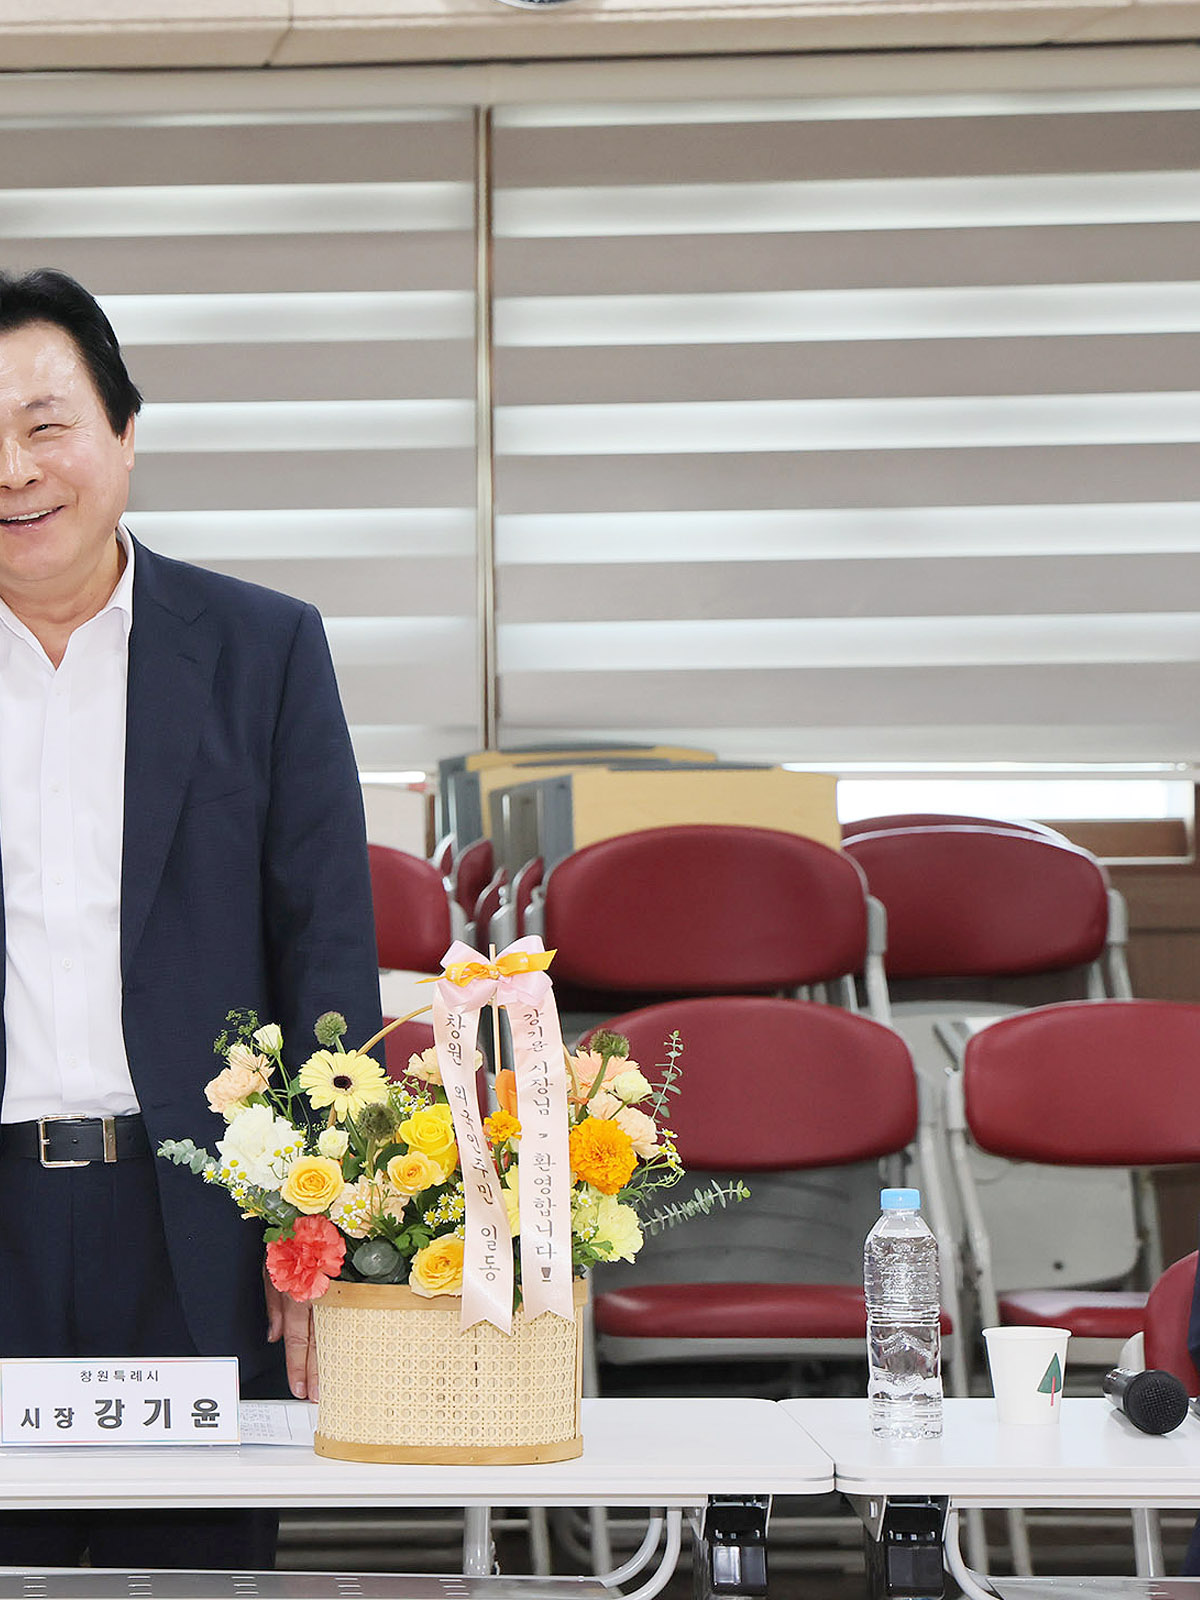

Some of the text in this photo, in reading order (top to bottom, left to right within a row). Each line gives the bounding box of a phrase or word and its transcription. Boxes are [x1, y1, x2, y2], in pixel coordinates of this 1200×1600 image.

[523, 1009, 549, 1053] 강기윤
[445, 1013, 466, 1066] 창원
[479, 1224, 500, 1282] 일동
[80, 1369, 159, 1383] 창원특례시
[20, 1407, 75, 1430] 시장
[94, 1398, 220, 1430] 강기윤
